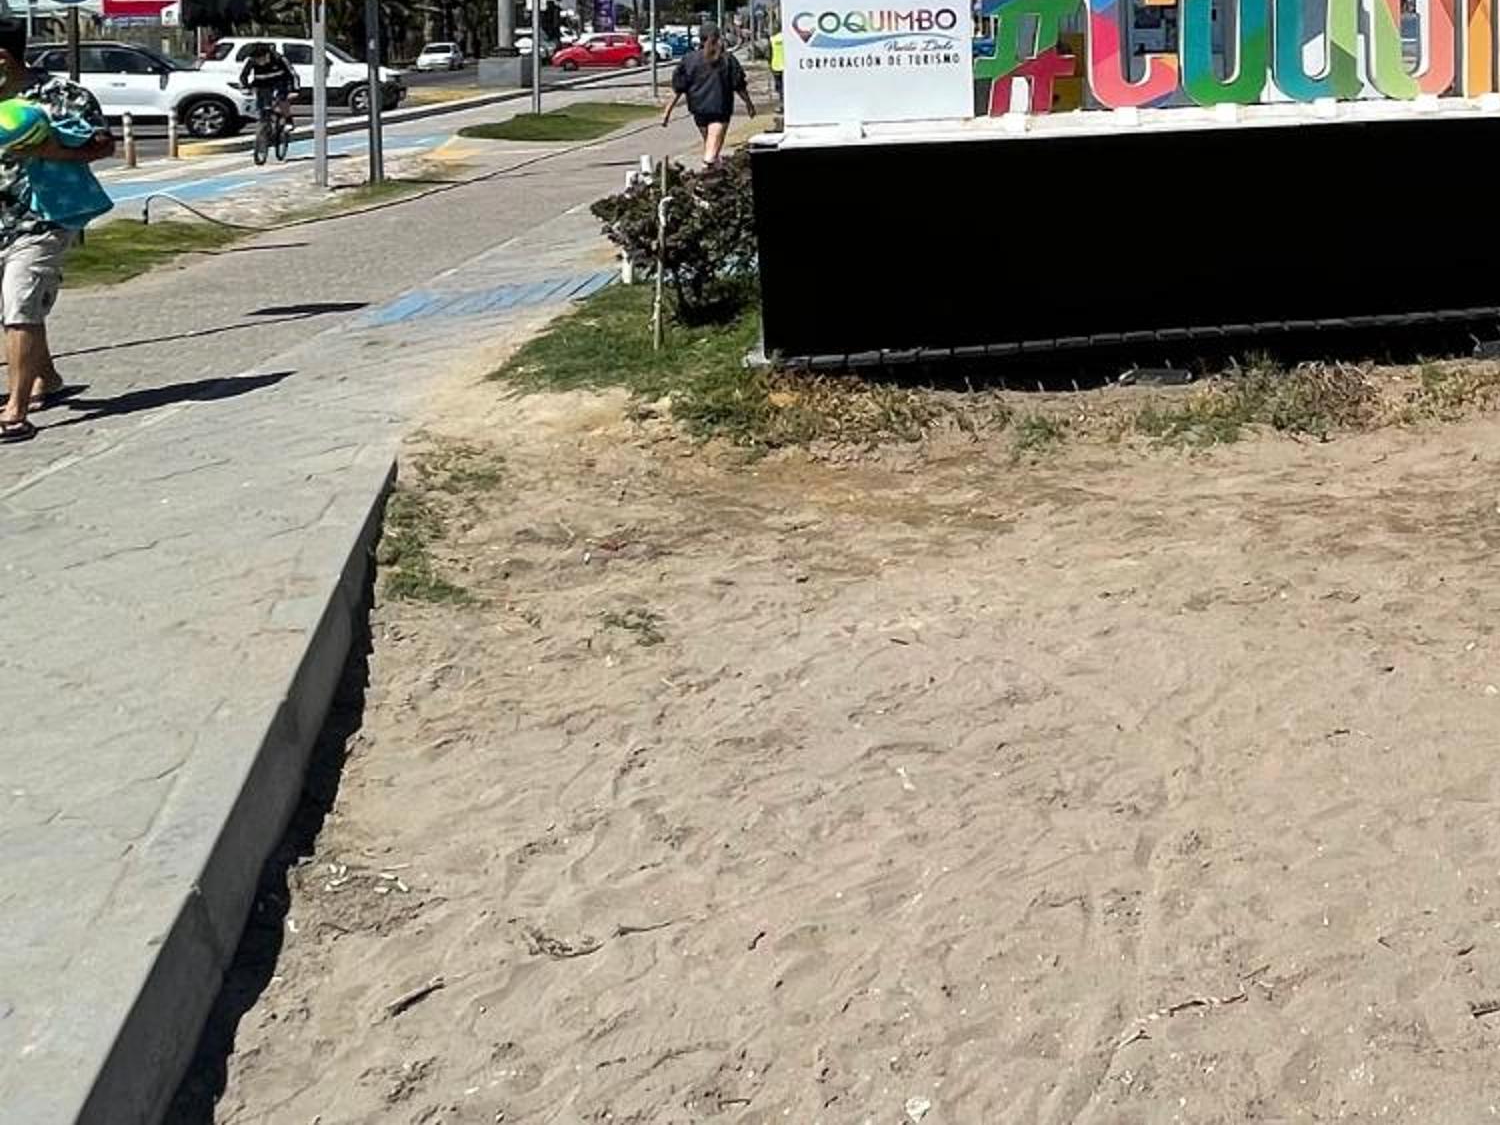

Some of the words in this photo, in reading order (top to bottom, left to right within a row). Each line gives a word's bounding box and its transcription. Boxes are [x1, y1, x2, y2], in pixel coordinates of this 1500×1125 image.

[792, 8, 957, 43] COQUIMBO
[800, 55, 881, 69] CORPORACIÓN
[888, 55, 901, 66] DE
[909, 52, 960, 65] TURISMO
